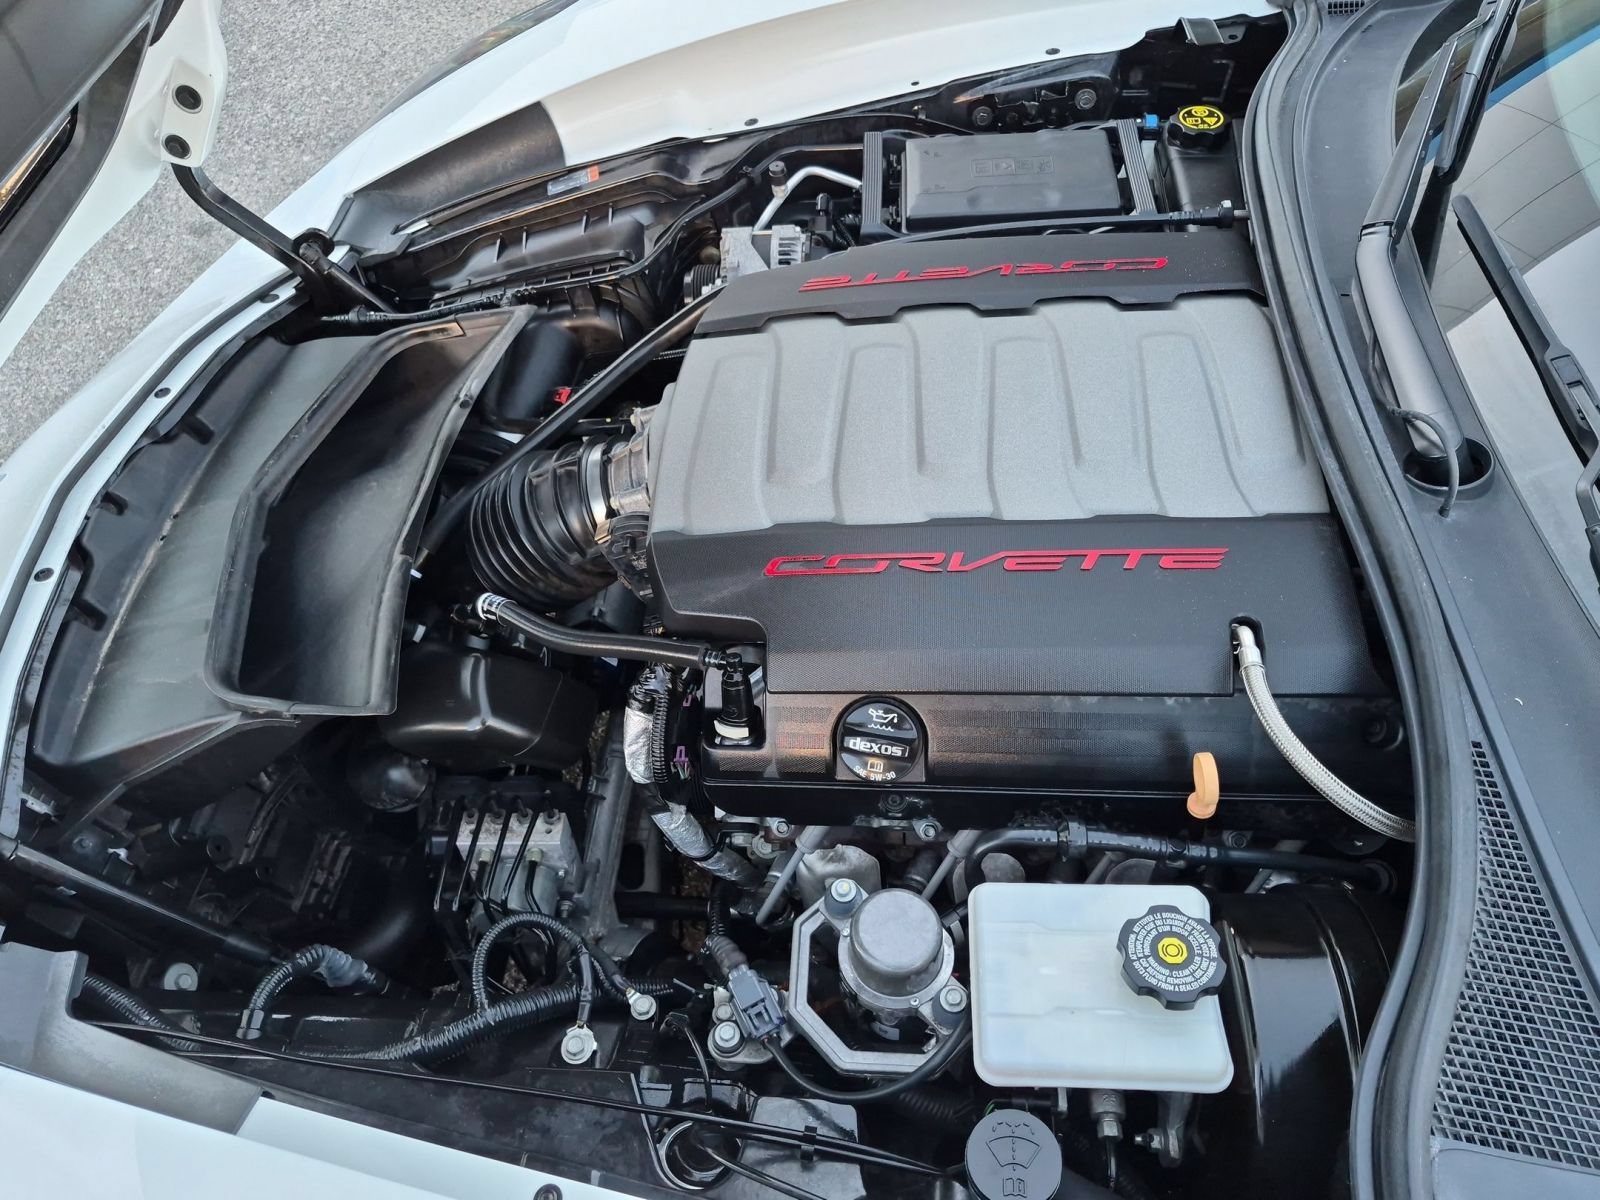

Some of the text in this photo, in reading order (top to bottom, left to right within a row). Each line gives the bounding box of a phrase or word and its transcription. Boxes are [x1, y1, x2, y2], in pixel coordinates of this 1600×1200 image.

[799, 256, 1168, 291] CORVETTE
[764, 547, 1229, 577] CORVETTE
[854, 765, 868, 778] SAE
[1133, 914, 1154, 932] NETTOYER
[1162, 912, 1188, 922] BOUCHON
[1188, 918, 1204, 932] AVANT
[1203, 931, 1210, 940] LA
[1145, 922, 1156, 931] QUE
[1163, 918, 1185, 928] LIQUIDE
[1184, 924, 1192, 932] DE
[1192, 929, 1205, 944] FREIN
[1143, 928, 1158, 956] PROVENANT
[1172, 926, 1190, 937] BIDON
[1132, 960, 1146, 975] DOT3
[1142, 971, 1159, 986] FLUID
[1158, 980, 1174, 991] FROM
[1179, 982, 1200, 992] SEALED
[1140, 958, 1149, 969] CAP
[1146, 966, 1166, 982] BEFORE
[1193, 968, 1203, 978] USE
[1201, 958, 1210, 972] ONLY
[1172, 968, 1190, 978] CLEAN
[1189, 956, 1201, 972] FILLER
